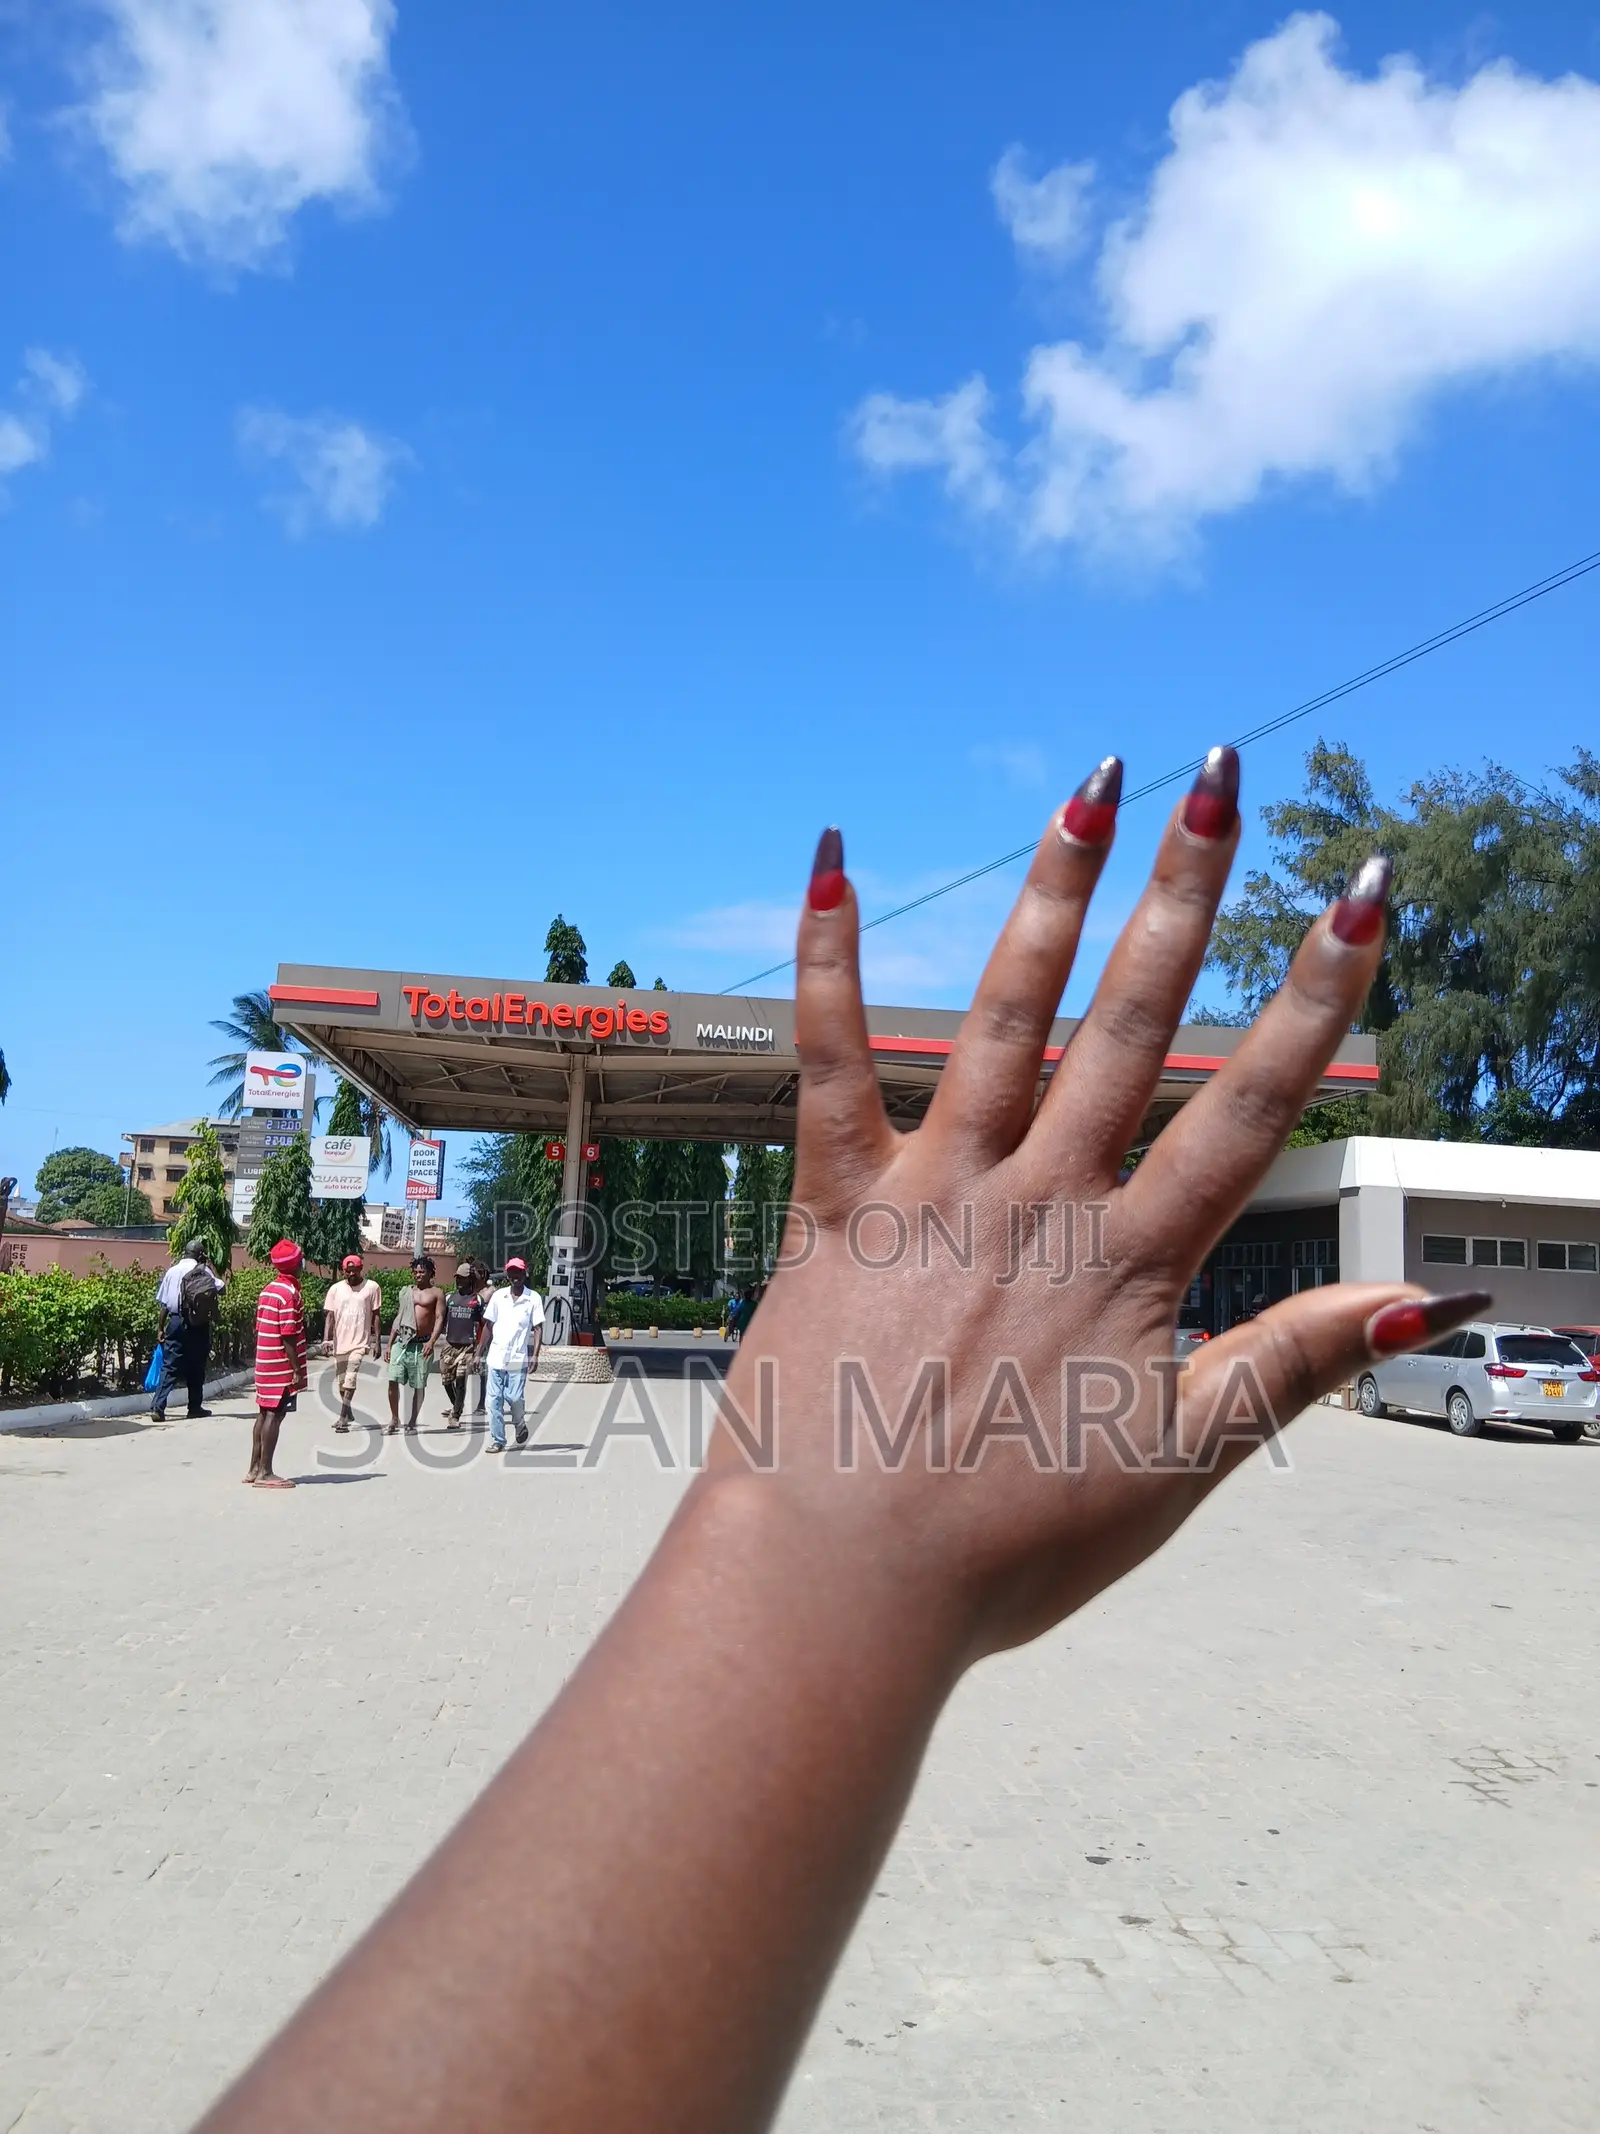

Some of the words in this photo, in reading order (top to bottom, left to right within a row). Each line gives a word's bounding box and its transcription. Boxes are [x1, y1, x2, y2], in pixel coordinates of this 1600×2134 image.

[403, 986, 668, 1037] TotalEnergies
[696, 1023, 774, 1043] MALINDI
[248, 1089, 301, 1099] TotalEnergies
[324, 1138, 352, 1150] café
[552, 1146, 560, 1157] 5
[586, 1147, 595, 1158] 6
[412, 1159, 437, 1167] THESE
[313, 1175, 363, 1184] QUARTZ
[594, 1177, 600, 1187] 2
